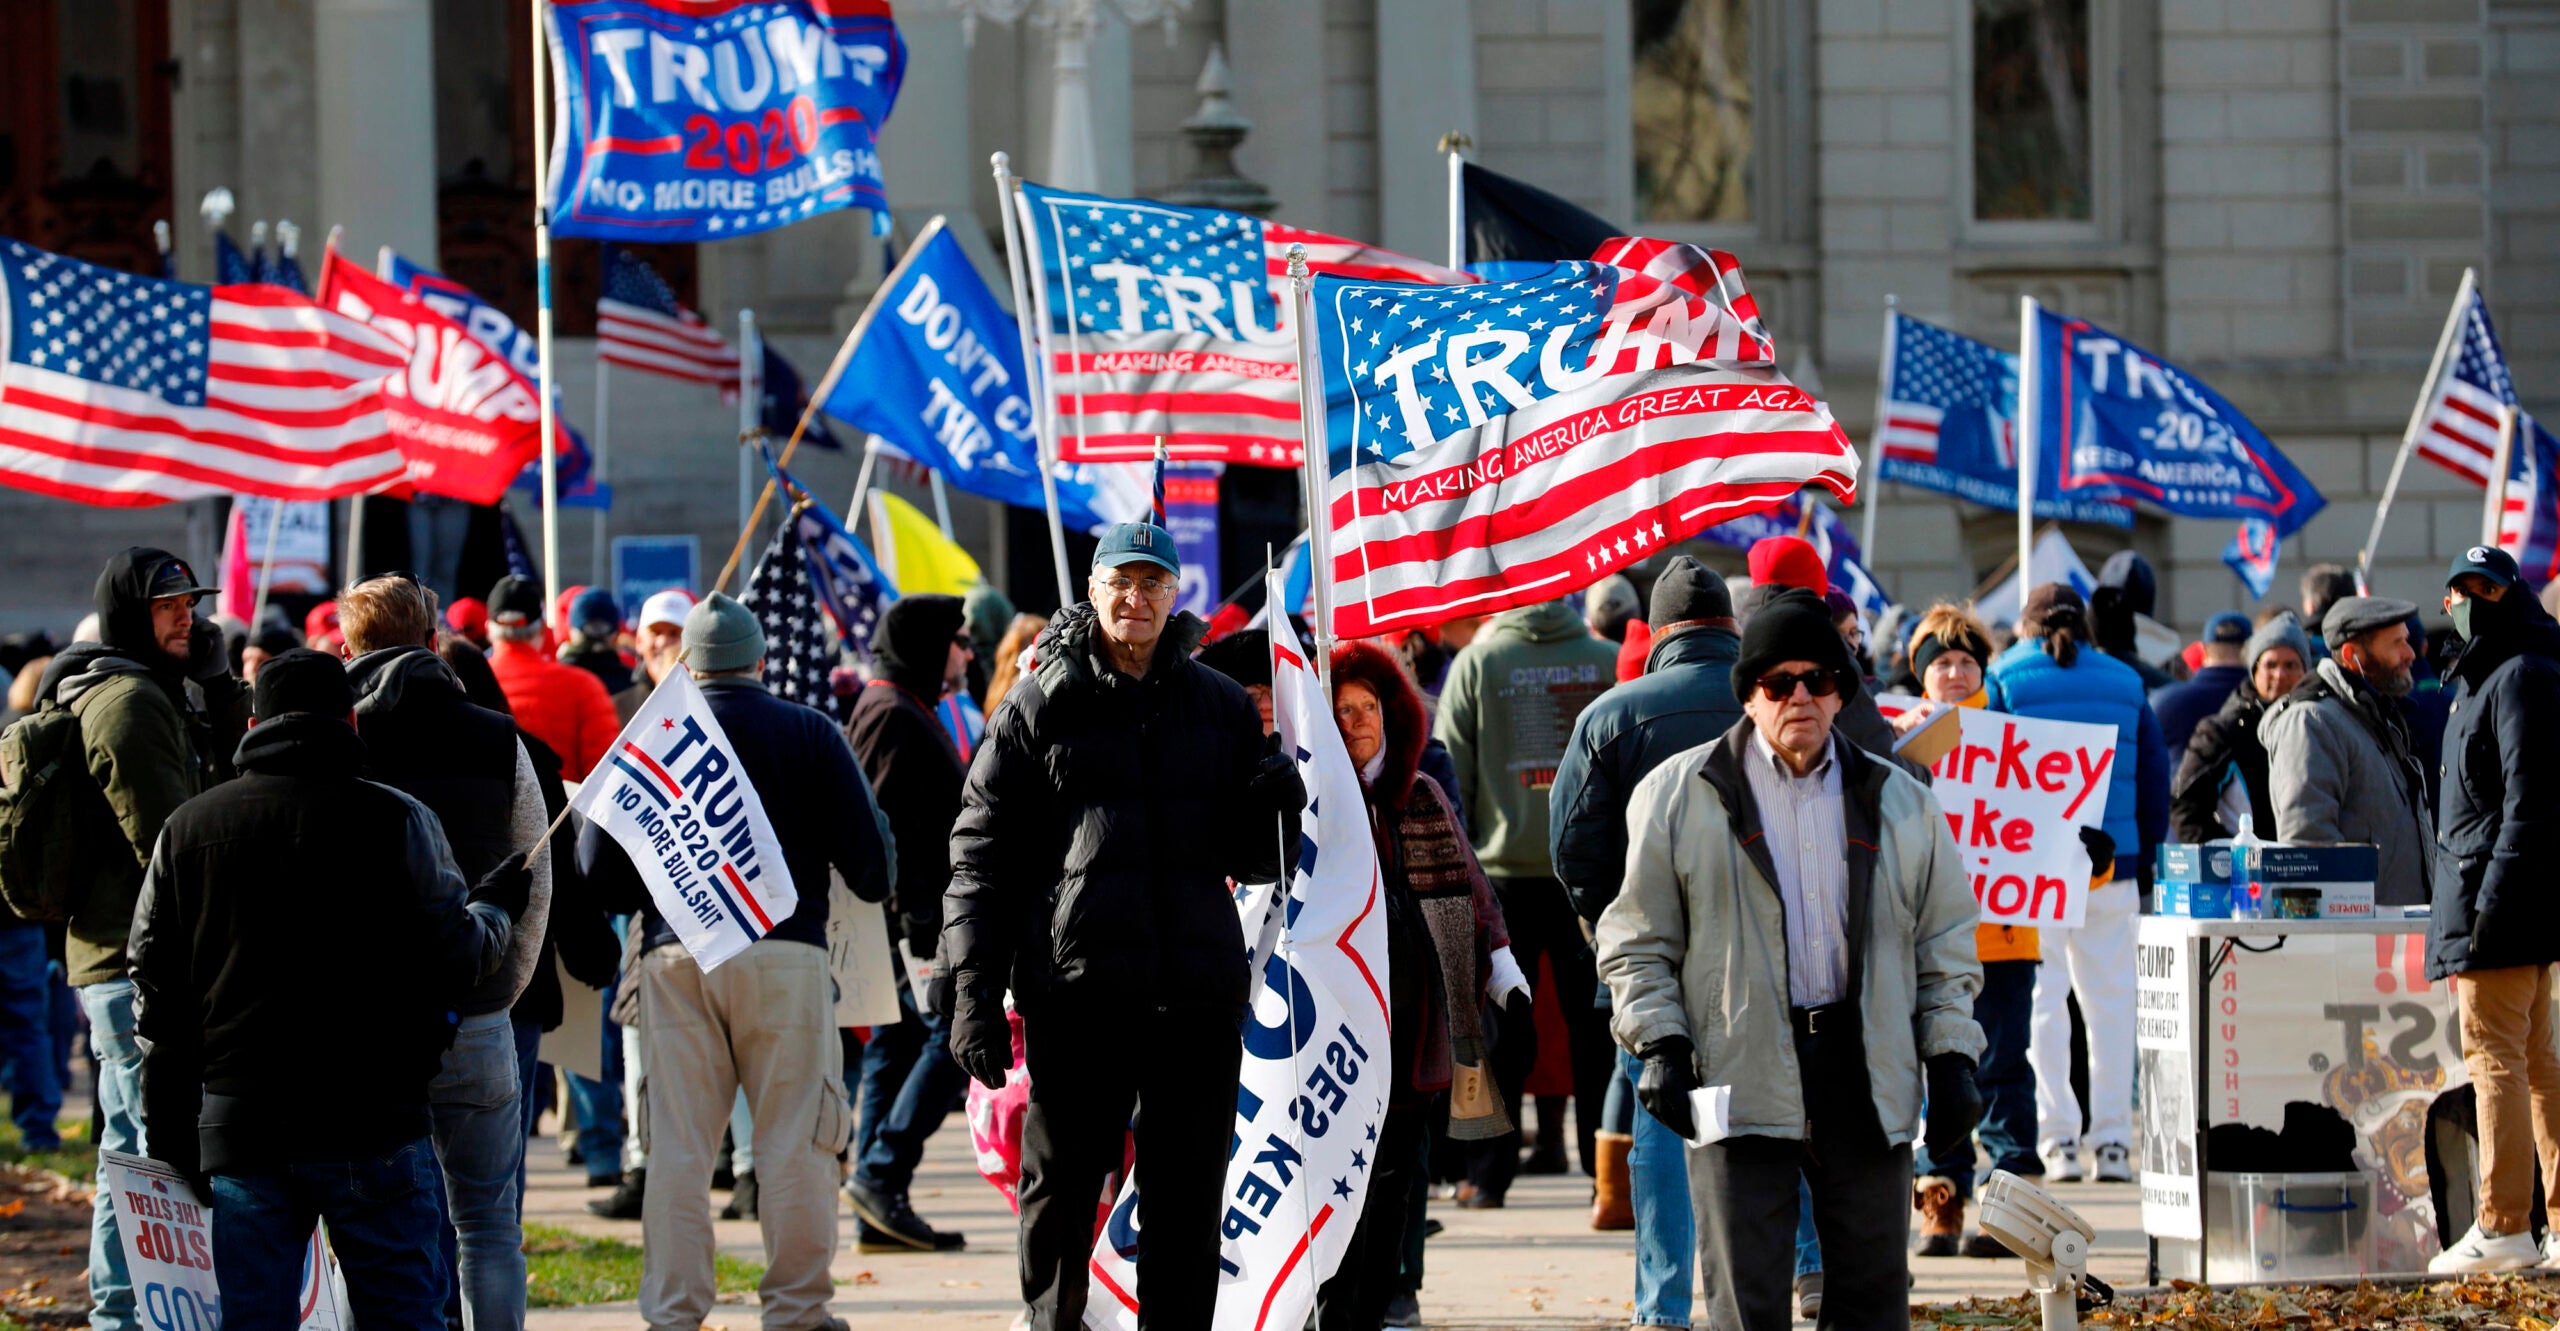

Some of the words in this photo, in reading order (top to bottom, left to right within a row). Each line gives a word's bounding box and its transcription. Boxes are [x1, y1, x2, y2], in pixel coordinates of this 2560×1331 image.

[591, 16, 888, 112] TRUMP
[684, 95, 818, 175] 2020
[591, 177, 645, 211] NO
[654, 179, 756, 212] MORE
[1093, 352, 1194, 371] MAKING
[1201, 353, 1298, 380] AMERICA
[1382, 453, 1504, 510] MAKING
[1513, 409, 1611, 470] AMERICA
[1618, 388, 1731, 423] GREAT
[2137, 458, 2242, 489] AMERICA
[611, 783, 642, 811] NO
[635, 805, 676, 857] MORE
[664, 851, 724, 929] BULLSHIT
[670, 804, 719, 871] 2020
[1966, 857, 2067, 921] ion
[2329, 902, 2370, 914] STAPLES
[124, 1190, 173, 1222] STEAL
[169, 1201, 206, 1228] THE
[136, 1219, 213, 1272] STOP
